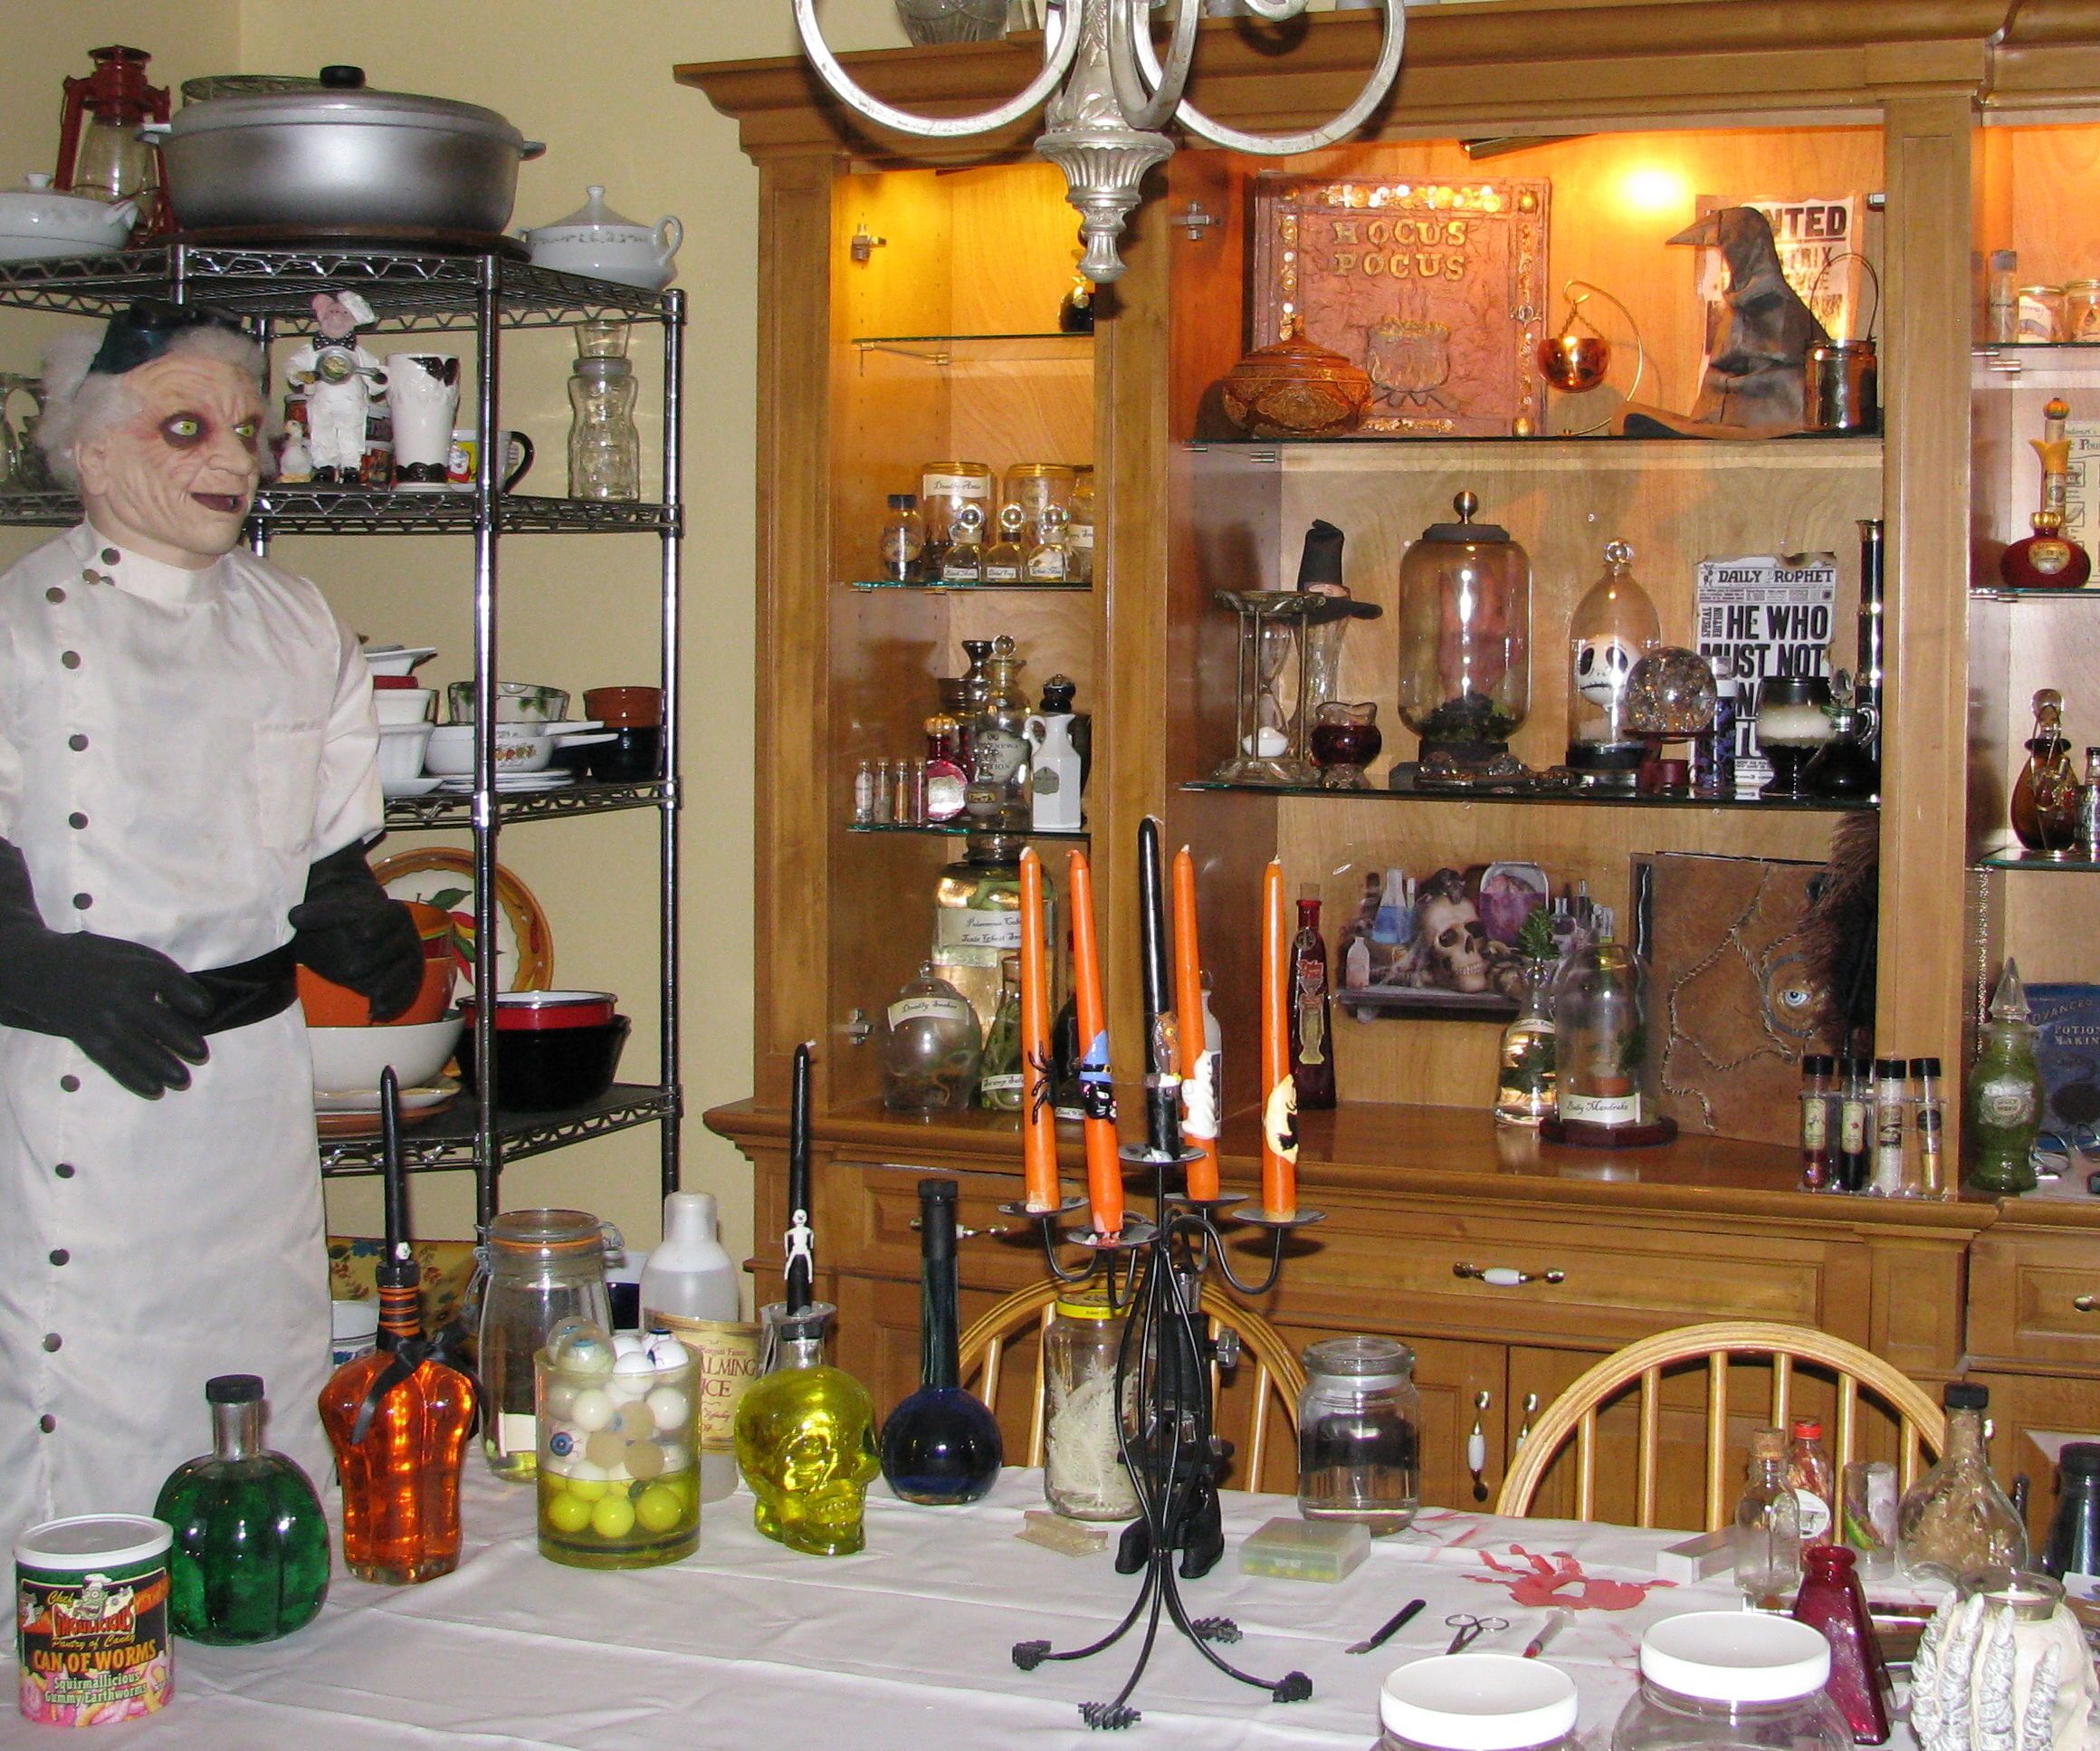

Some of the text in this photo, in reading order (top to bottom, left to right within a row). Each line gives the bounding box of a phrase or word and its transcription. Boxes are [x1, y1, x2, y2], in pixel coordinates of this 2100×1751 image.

[1332, 218, 1468, 247] HOCUS
[1761, 205, 1847, 239] NTED
[1334, 251, 1466, 282] POCUS
[1718, 569, 1762, 583] DAILY
[1726, 605, 1829, 641] HE WHO
[1777, 643, 1827, 677] NOT
[2032, 999, 2094, 1025] DVANCED
[702, 1357, 757, 1377] ALMING
[702, 1377, 731, 1398] ICE
[33, 1638, 157, 1673] CAN OF WORMS
[45, 1684, 147, 1708] Gummy Earthworms
